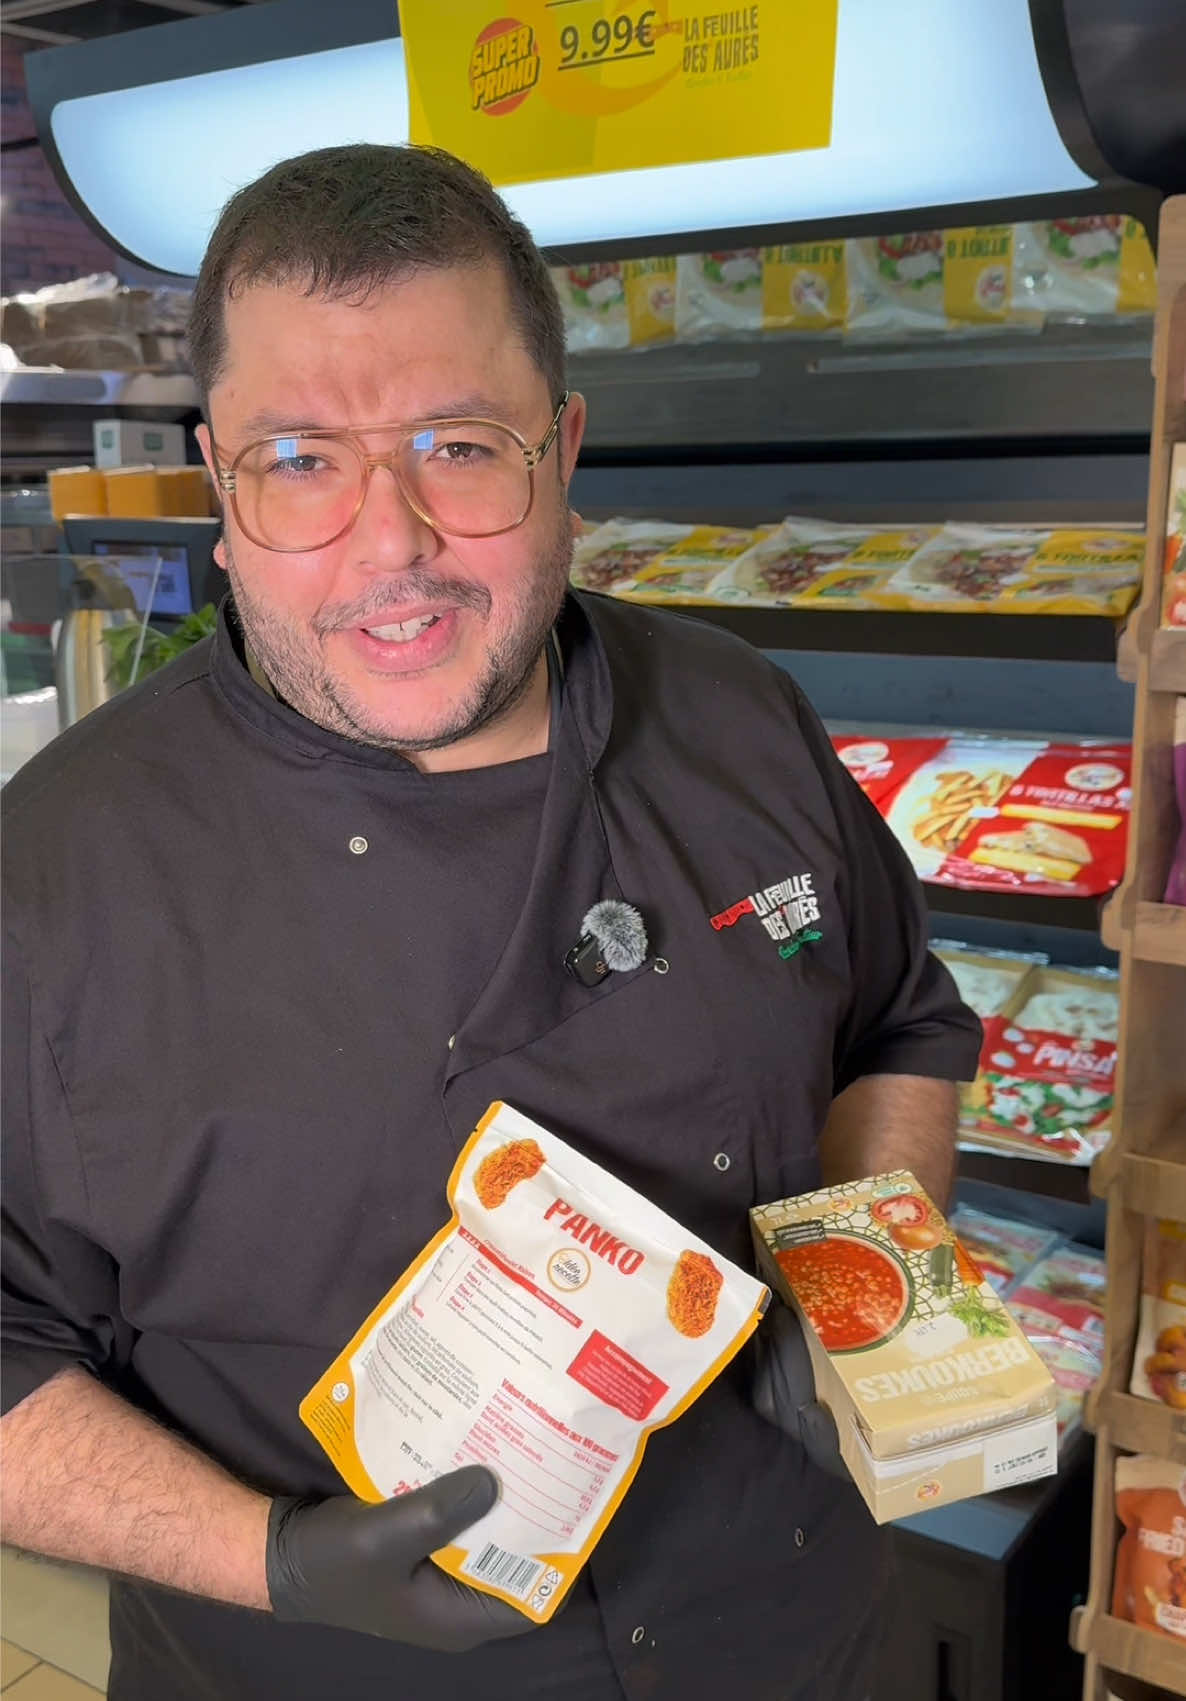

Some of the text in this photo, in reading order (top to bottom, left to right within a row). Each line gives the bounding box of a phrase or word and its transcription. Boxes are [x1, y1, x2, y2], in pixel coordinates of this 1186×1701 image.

[559, 10, 656, 64] 9.99€
[683, 5, 759, 42] LA FEUILLE
[472, 25, 535, 77] SUPER
[682, 34, 760, 74] DES AURES
[472, 55, 540, 111] PROMO
[748, 892, 772, 917] LA
[763, 873, 816, 909] FEUILLE
[543, 1197, 645, 1276] PANKO
